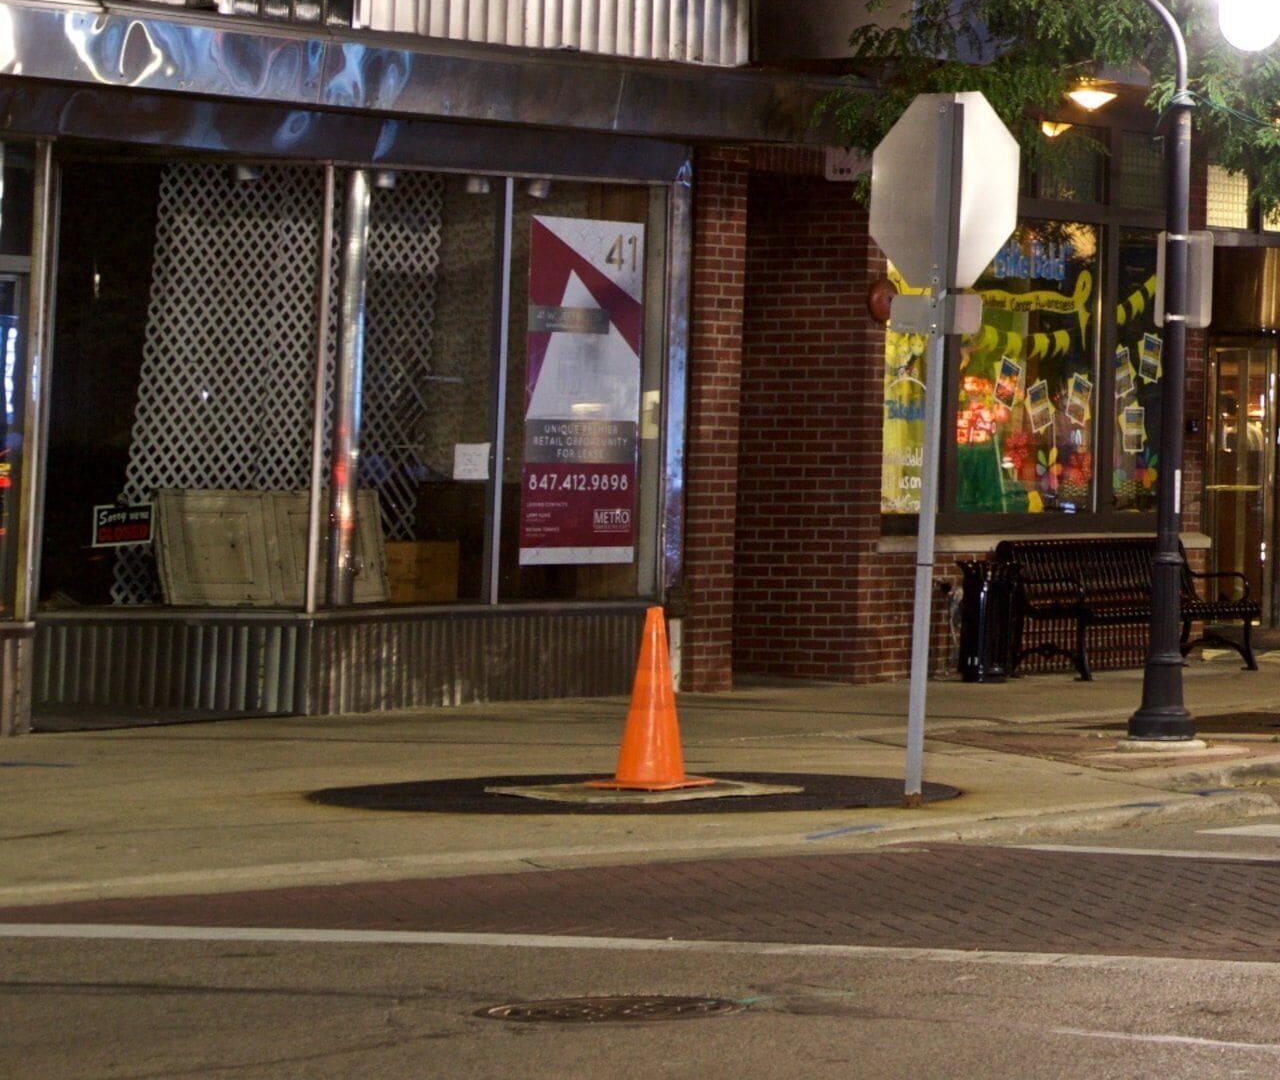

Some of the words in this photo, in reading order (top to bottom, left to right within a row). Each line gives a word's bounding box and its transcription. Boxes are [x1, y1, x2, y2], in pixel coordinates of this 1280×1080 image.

[605, 234, 637, 272] 41
[544, 424, 579, 435] UNIQUE
[533, 436, 563, 446] RETAIL
[557, 449, 575, 458] FOR
[528, 473, 629, 490] 847.412.9898
[594, 511, 630, 524] METRO
